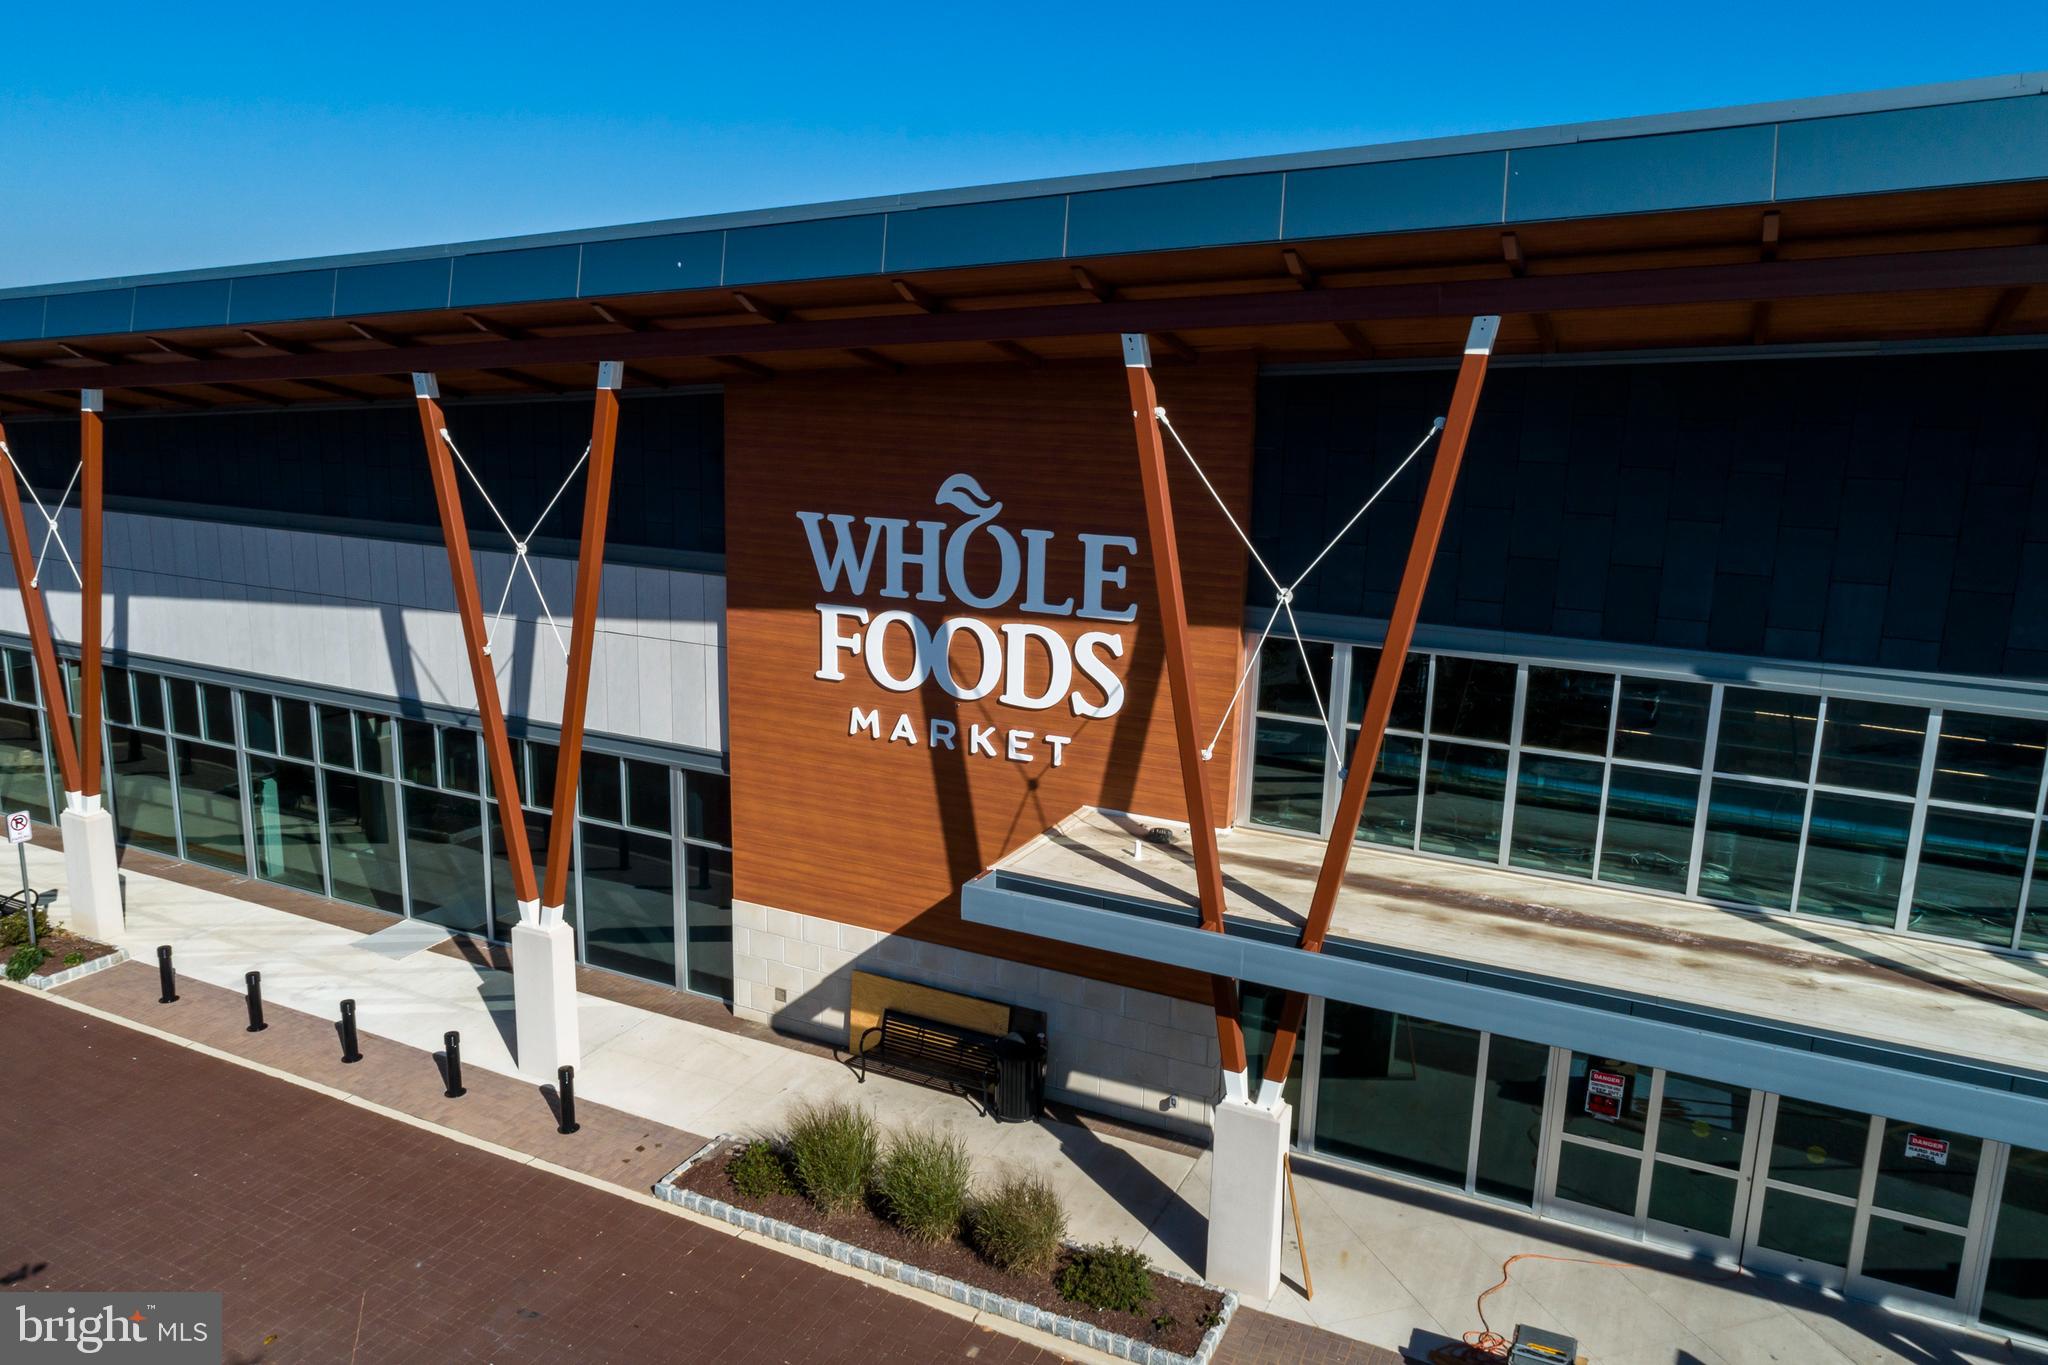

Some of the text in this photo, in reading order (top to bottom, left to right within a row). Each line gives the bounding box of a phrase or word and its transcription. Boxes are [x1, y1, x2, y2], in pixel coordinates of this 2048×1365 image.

[796, 500, 1138, 622] WHOLE
[815, 603, 1125, 719] FOODS
[849, 706, 1071, 767] MARKET
[1593, 1073, 1621, 1084] DANGER
[1908, 1146, 1929, 1154] HARD
[1912, 1137, 1944, 1150] DANGER
